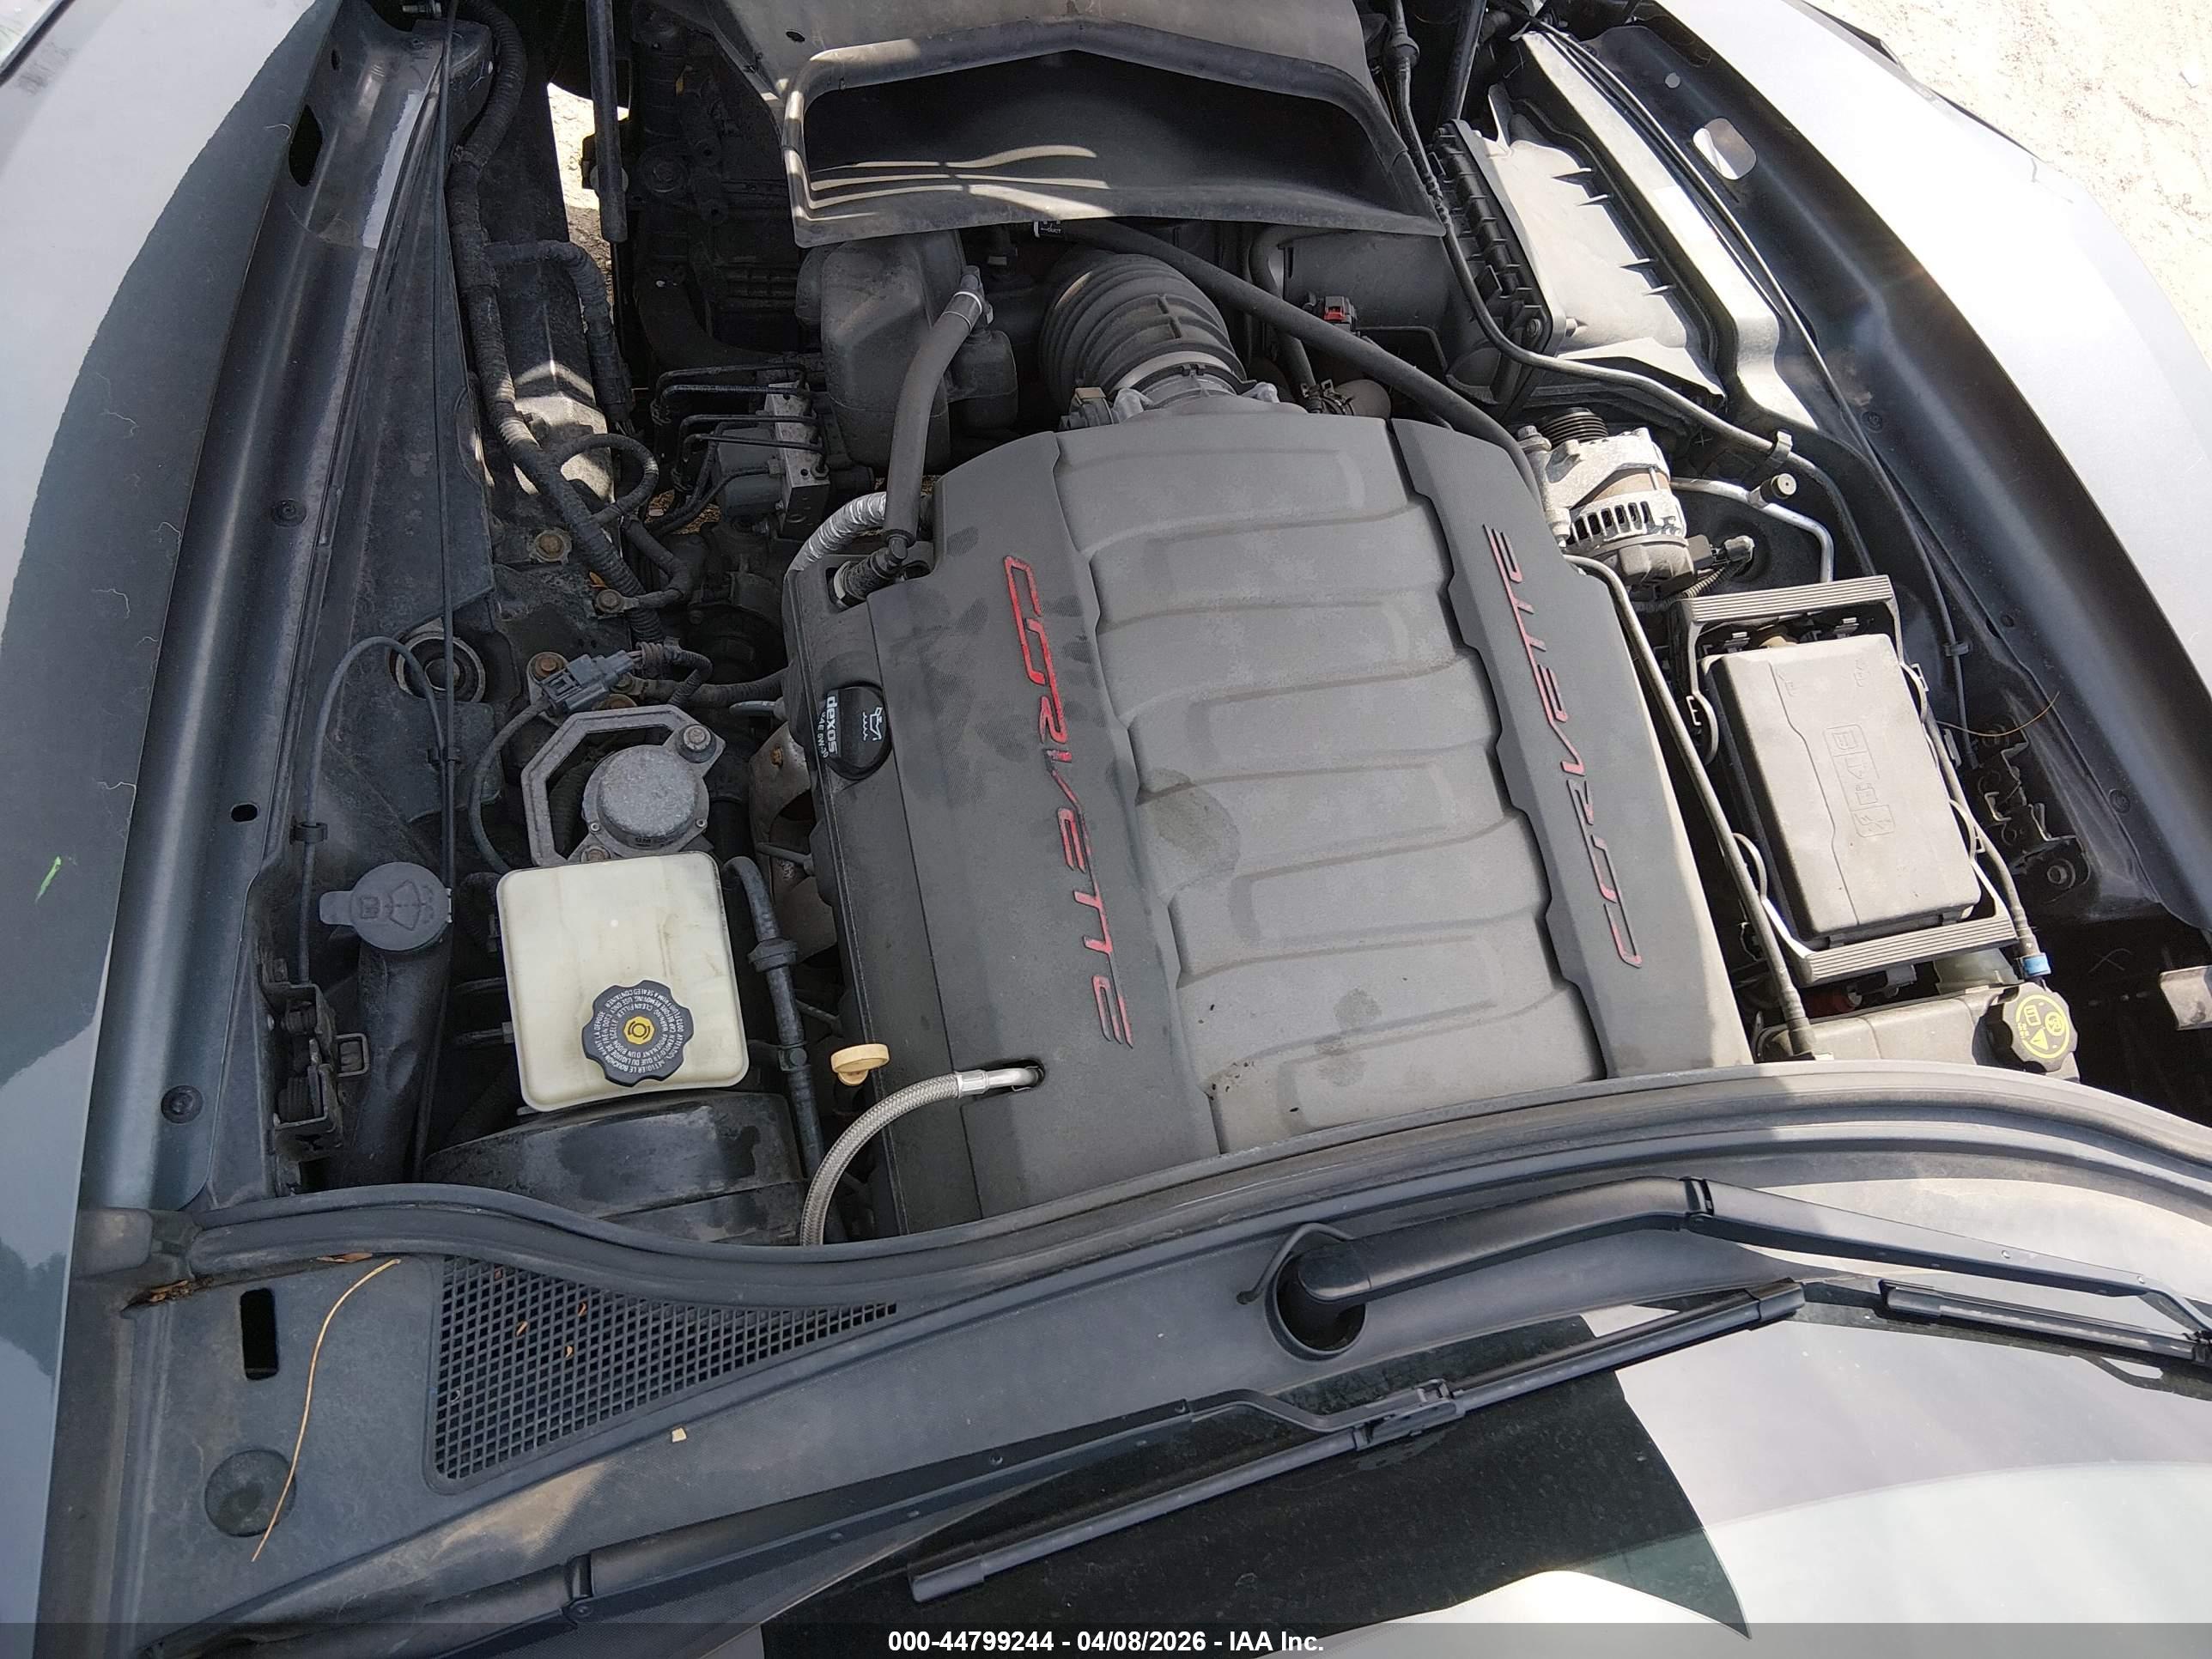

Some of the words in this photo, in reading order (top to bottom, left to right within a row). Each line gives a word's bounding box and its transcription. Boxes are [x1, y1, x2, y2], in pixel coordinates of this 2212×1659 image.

[826, 696, 837, 754] dexos
[1484, 524, 1642, 968] CORVETTE
[1005, 556, 1133, 1048] CORVETTE
[602, 988, 633, 1008] CONTAINER
[614, 1003, 634, 1018] FILLER
[658, 1003, 676, 1023] BEFORE
[668, 1021, 677, 1032] CAP
[603, 1053, 629, 1072] BOUCHON
[640, 1056, 654, 1066] QUE
